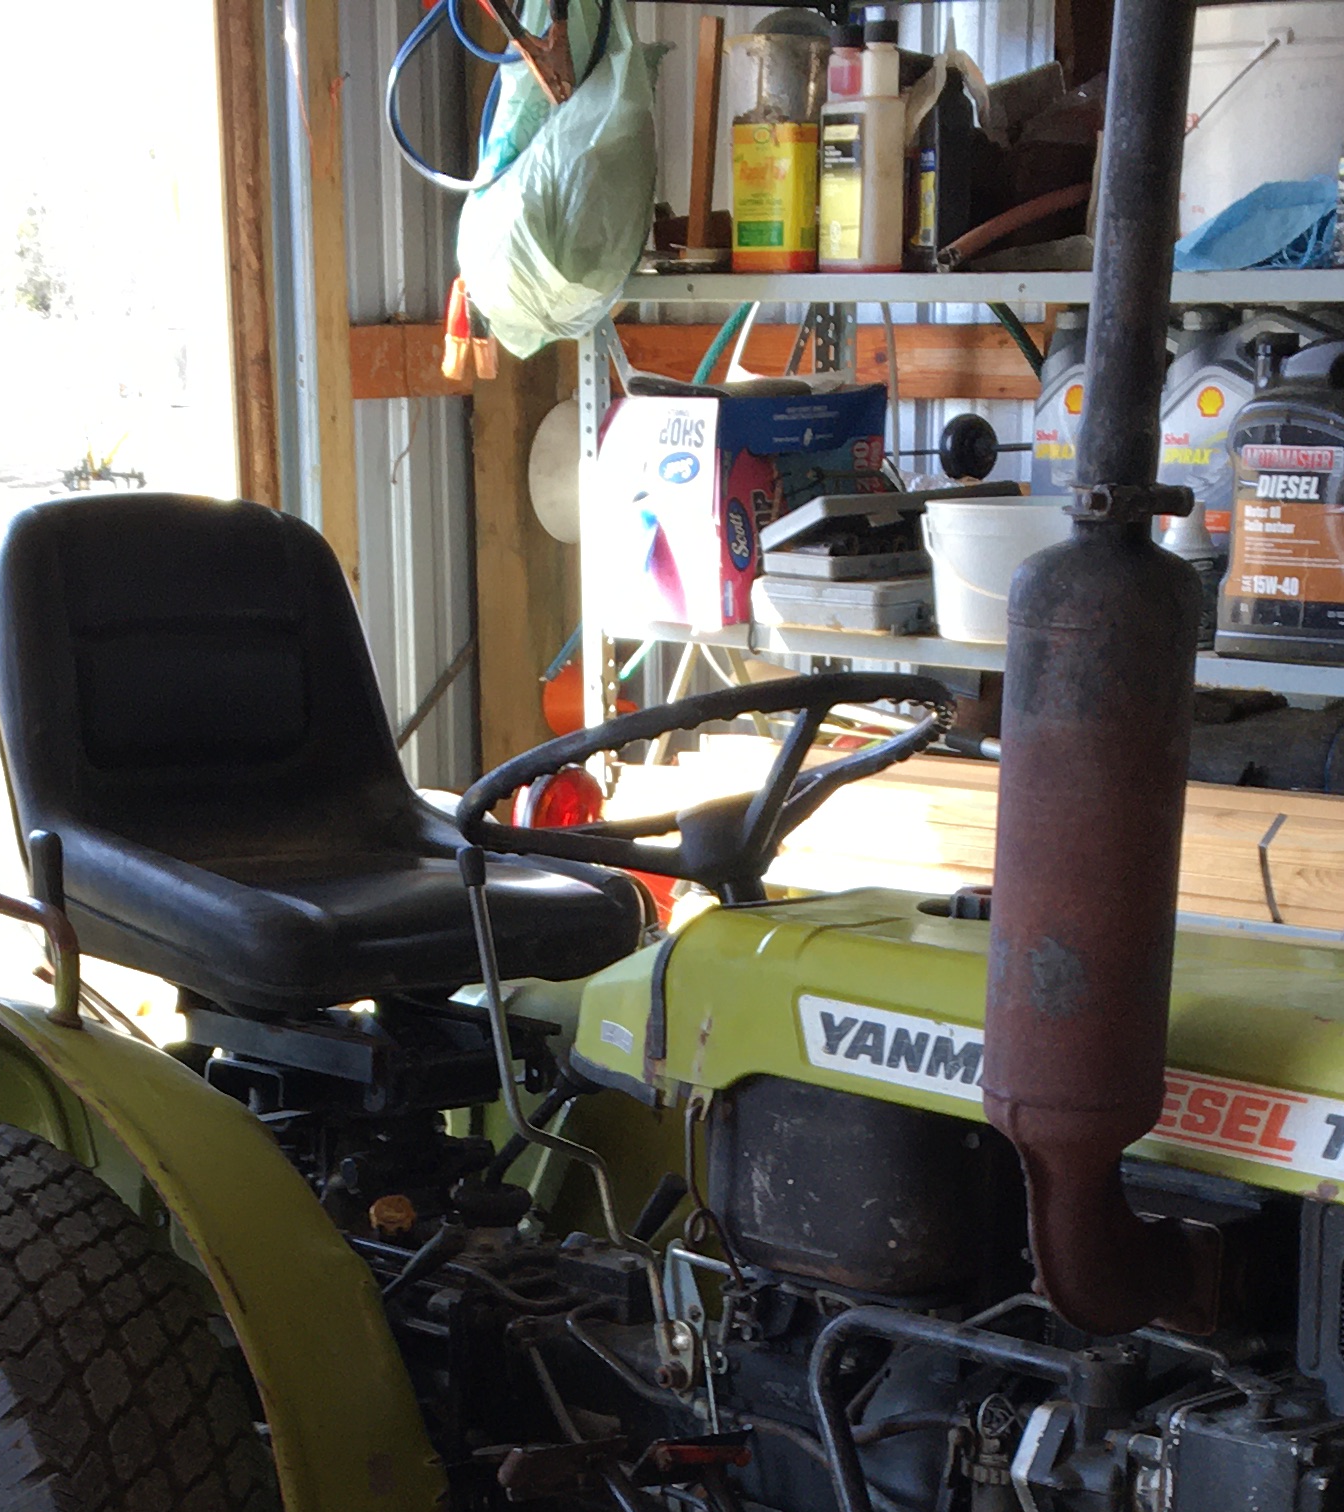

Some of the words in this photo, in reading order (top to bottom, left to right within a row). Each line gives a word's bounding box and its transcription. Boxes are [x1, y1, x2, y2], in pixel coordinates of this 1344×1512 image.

[659, 417, 705, 447] SHOP
[1036, 430, 1058, 441] Shell
[1164, 433, 1190, 445] Shell
[1163, 447, 1211, 464] SPIRAX
[1246, 448, 1332, 470] MOTOMASTER
[1256, 475, 1320, 500] DIESEL
[730, 511, 750, 558] Scott
[1253, 575, 1300, 596] 15W-40
[819, 1010, 984, 1085] YANM
[1153, 1083, 1297, 1153] ESEL
